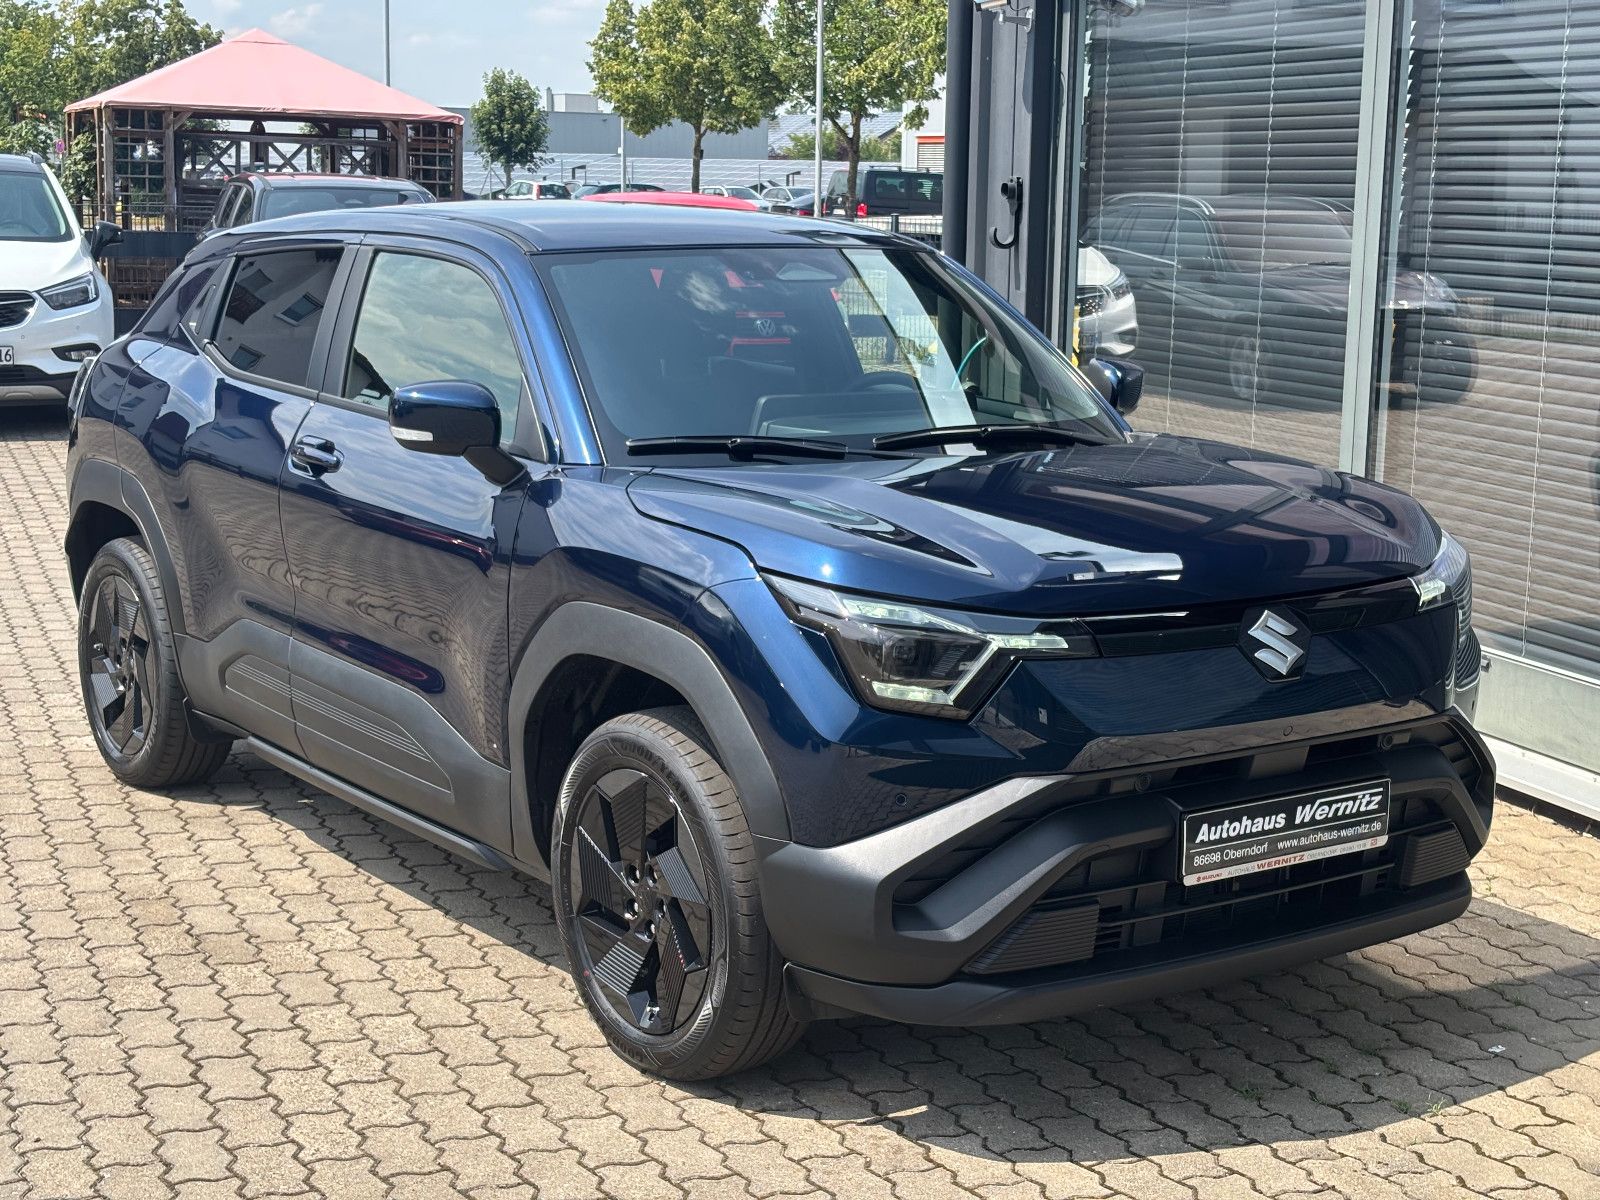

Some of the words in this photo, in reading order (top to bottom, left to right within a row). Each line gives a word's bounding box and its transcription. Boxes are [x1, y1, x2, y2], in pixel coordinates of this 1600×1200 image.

[1195, 813, 1287, 843] Autohaus
[1295, 790, 1383, 824] Wernitz
[1193, 852, 1221, 867] 86698
[1223, 842, 1269, 860] Oberndorf
[1277, 820, 1382, 850] www.autohaus-wernitz.de
[1256, 854, 1306, 870] WERNITZ
